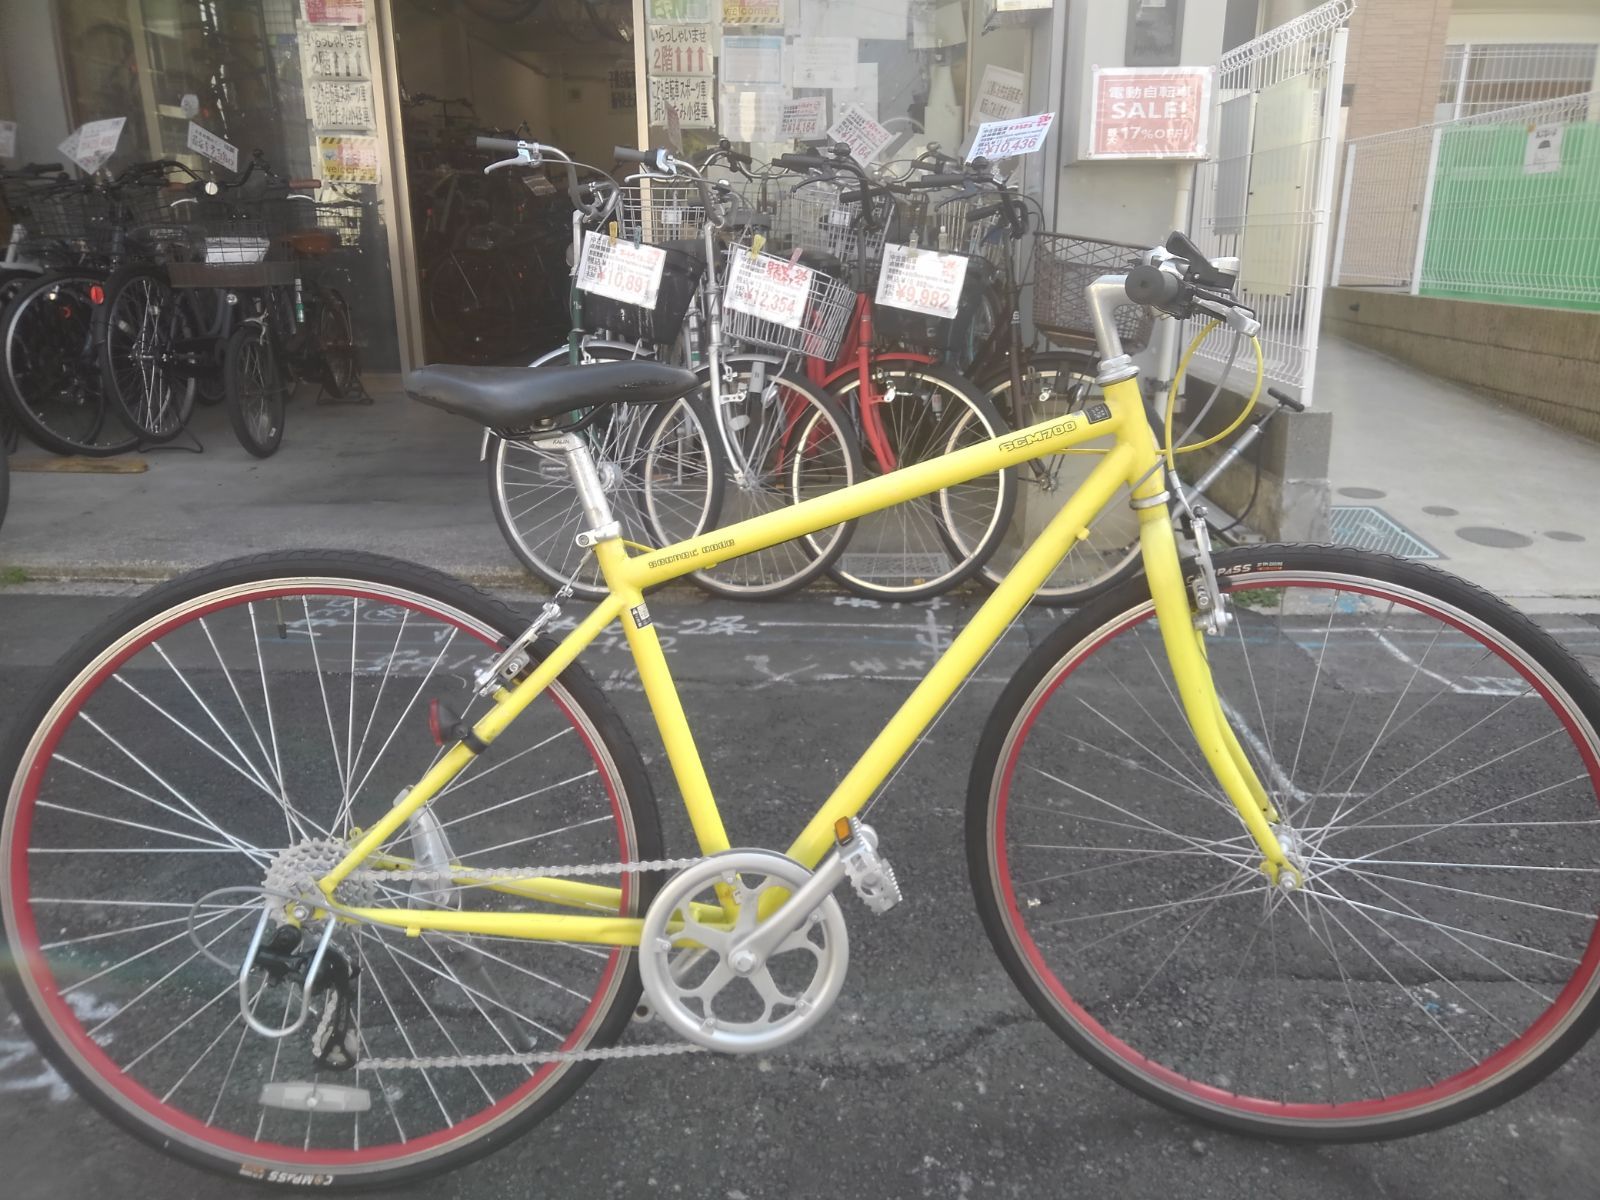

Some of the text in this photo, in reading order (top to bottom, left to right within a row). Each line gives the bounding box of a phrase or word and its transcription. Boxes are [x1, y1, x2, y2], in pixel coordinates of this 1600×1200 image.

[651, 28, 706, 43] いらっしゃいませ
[654, 46, 673, 72] 2階
[1111, 101, 1188, 119] SALE!
[985, 137, 1037, 155] ¥10,436
[743, 286, 796, 316] ¥12,354
